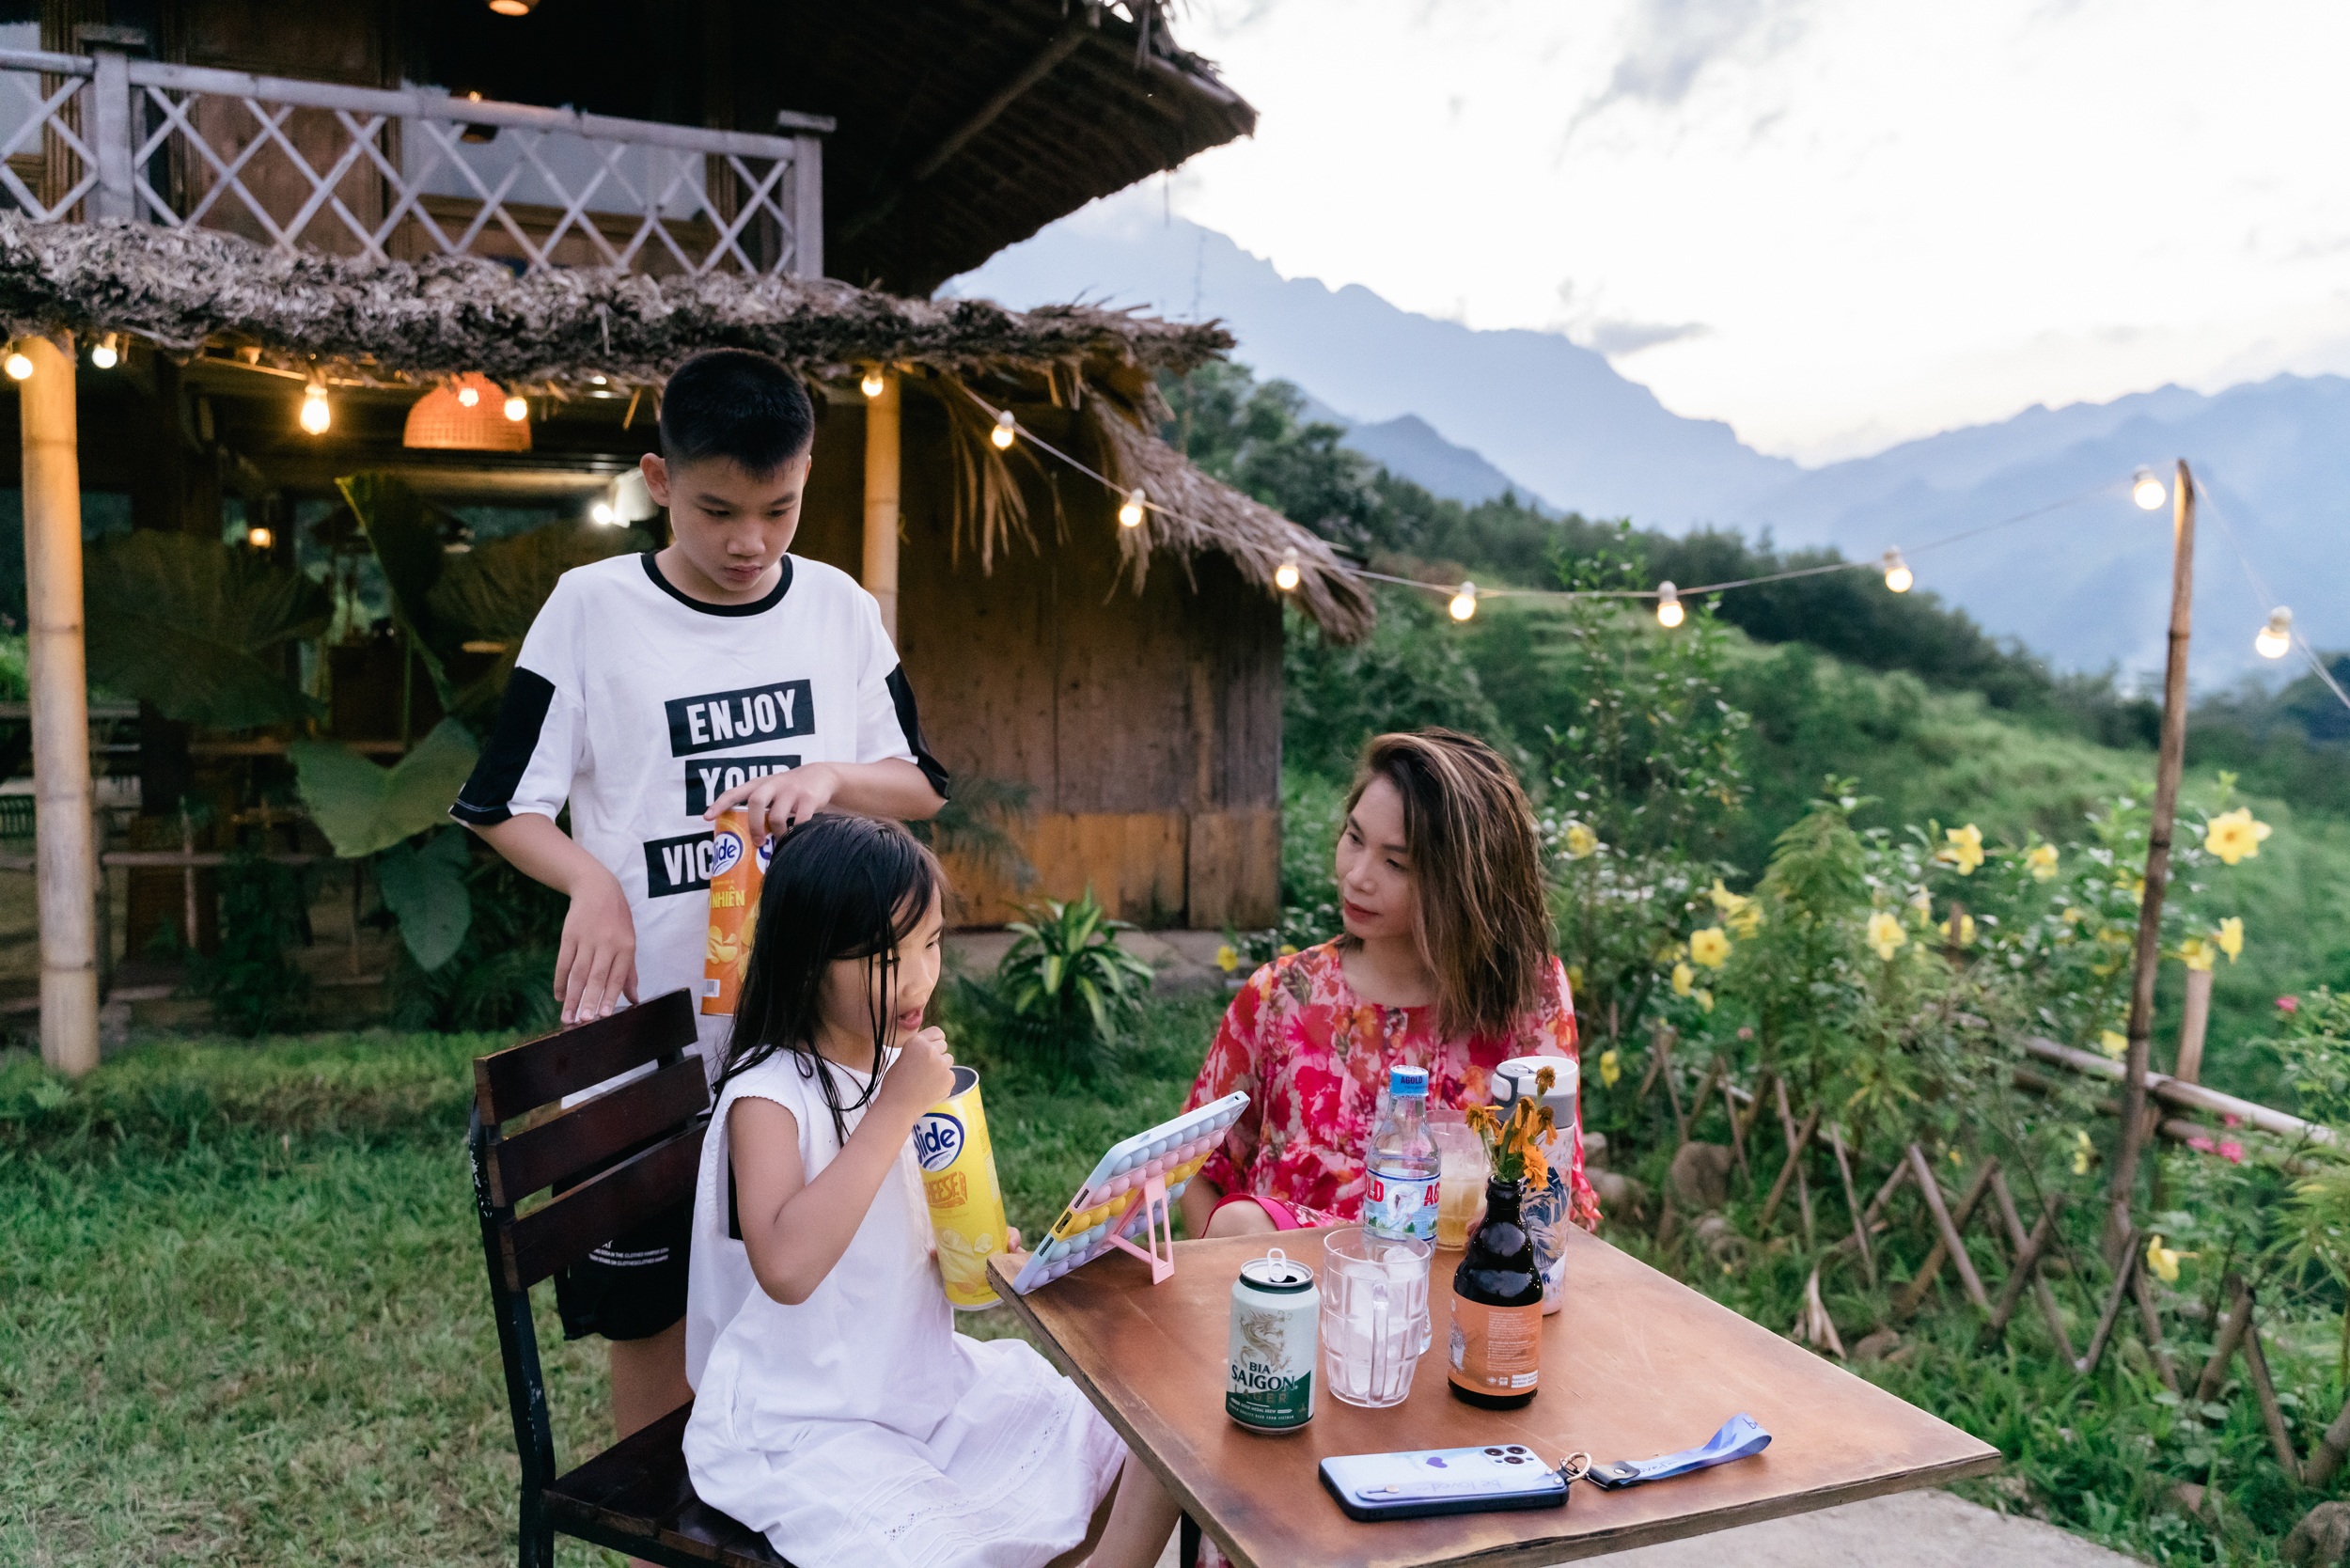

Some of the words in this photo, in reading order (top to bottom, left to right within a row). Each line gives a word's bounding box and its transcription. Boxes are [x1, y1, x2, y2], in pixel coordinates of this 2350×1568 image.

[686, 688, 796, 745] ENJOY
[697, 763, 791, 807] YO
[662, 839, 713, 886] VIC
[711, 886, 745, 909] NHIÊN
[1401, 1075, 1423, 1085] AGOLD
[1231, 1364, 1295, 1390] SAIGON
[1249, 1361, 1271, 1373] BIA
[1234, 1383, 1287, 1403] LAGER
